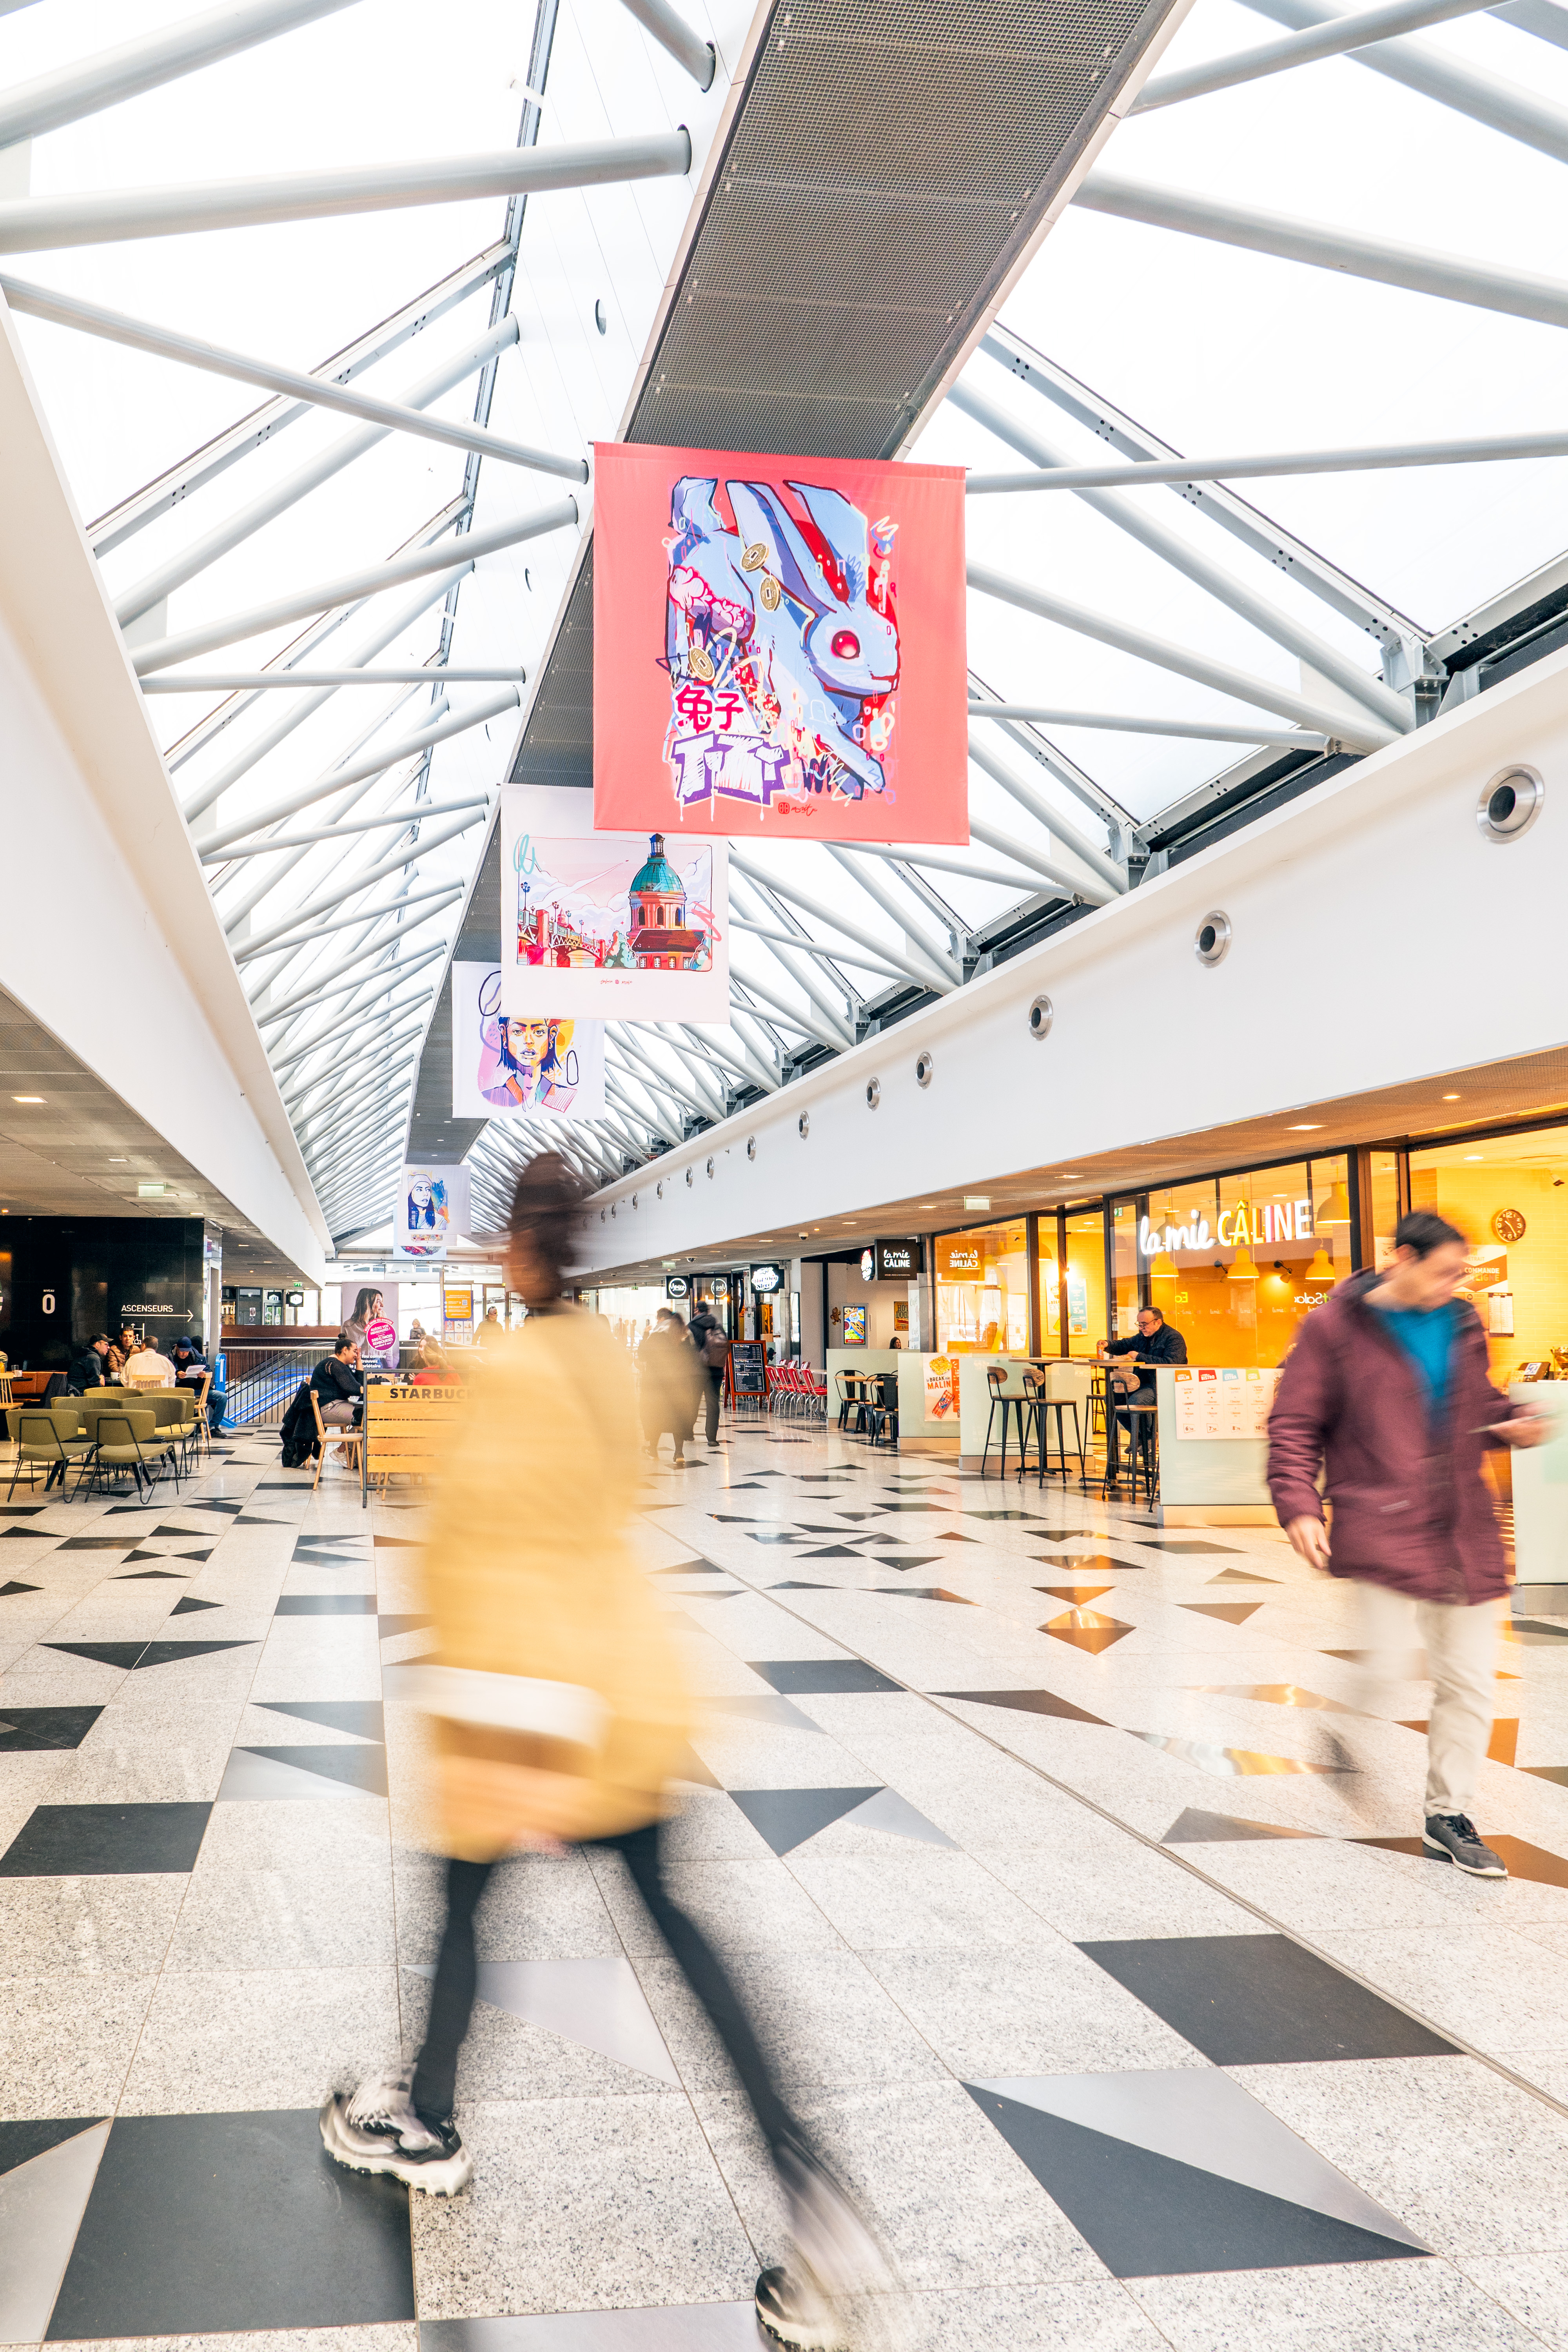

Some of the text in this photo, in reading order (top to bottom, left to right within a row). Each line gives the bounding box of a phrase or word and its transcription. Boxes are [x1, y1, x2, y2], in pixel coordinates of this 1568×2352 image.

[675, 684, 744, 734] 兔子
[1140, 1200, 1312, 1255] la mie CÂLINE
[884, 1249, 910, 1258] la mie
[884, 1258, 911, 1267] CÂLINE
[42, 1294, 55, 1314] 0
[927, 1380, 951, 1390] MALIN
[390, 1388, 473, 1399] STARBUCK
